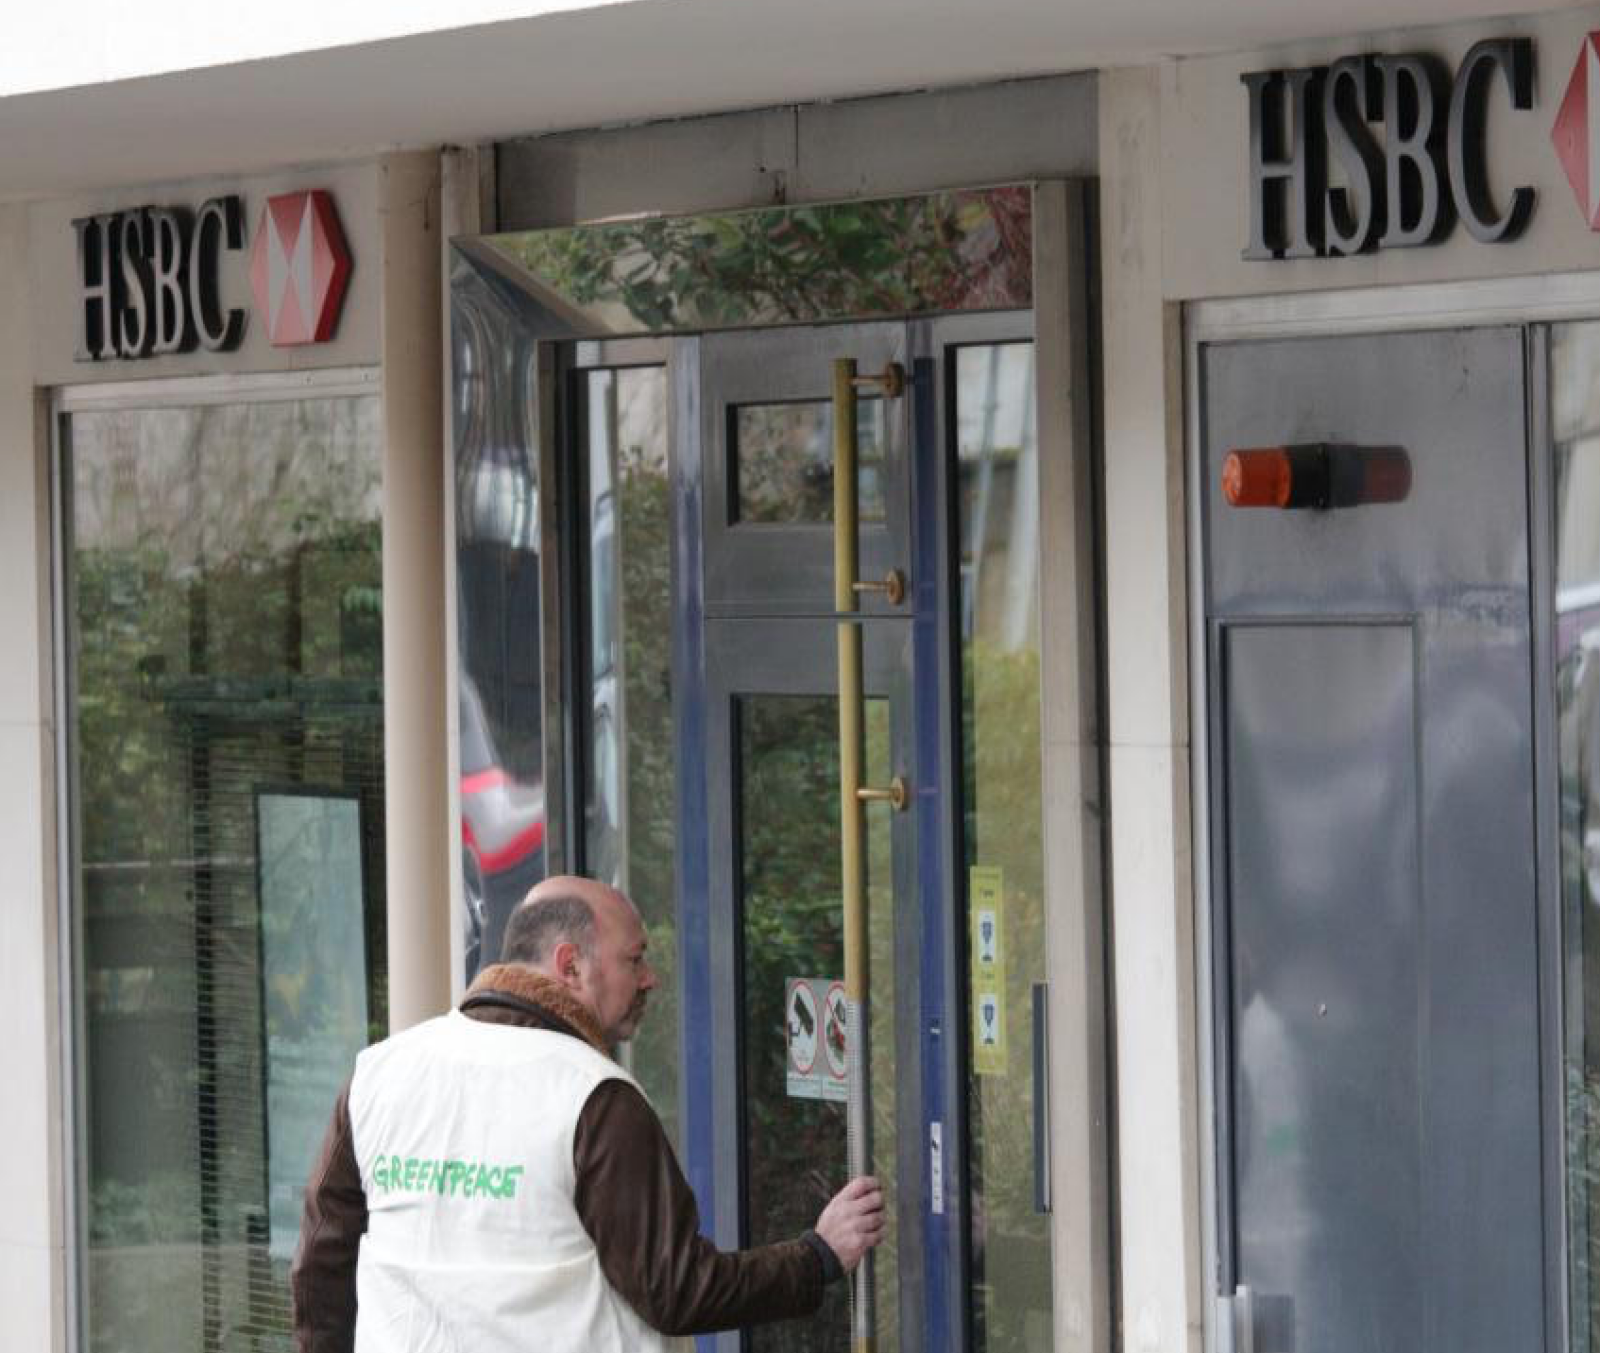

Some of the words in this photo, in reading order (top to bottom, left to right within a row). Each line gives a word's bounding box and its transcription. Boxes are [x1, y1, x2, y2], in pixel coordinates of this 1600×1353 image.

[1239, 36, 1538, 261] HSBC
[71, 194, 248, 363] HSBC
[373, 1154, 525, 1199] GREENPEACE
